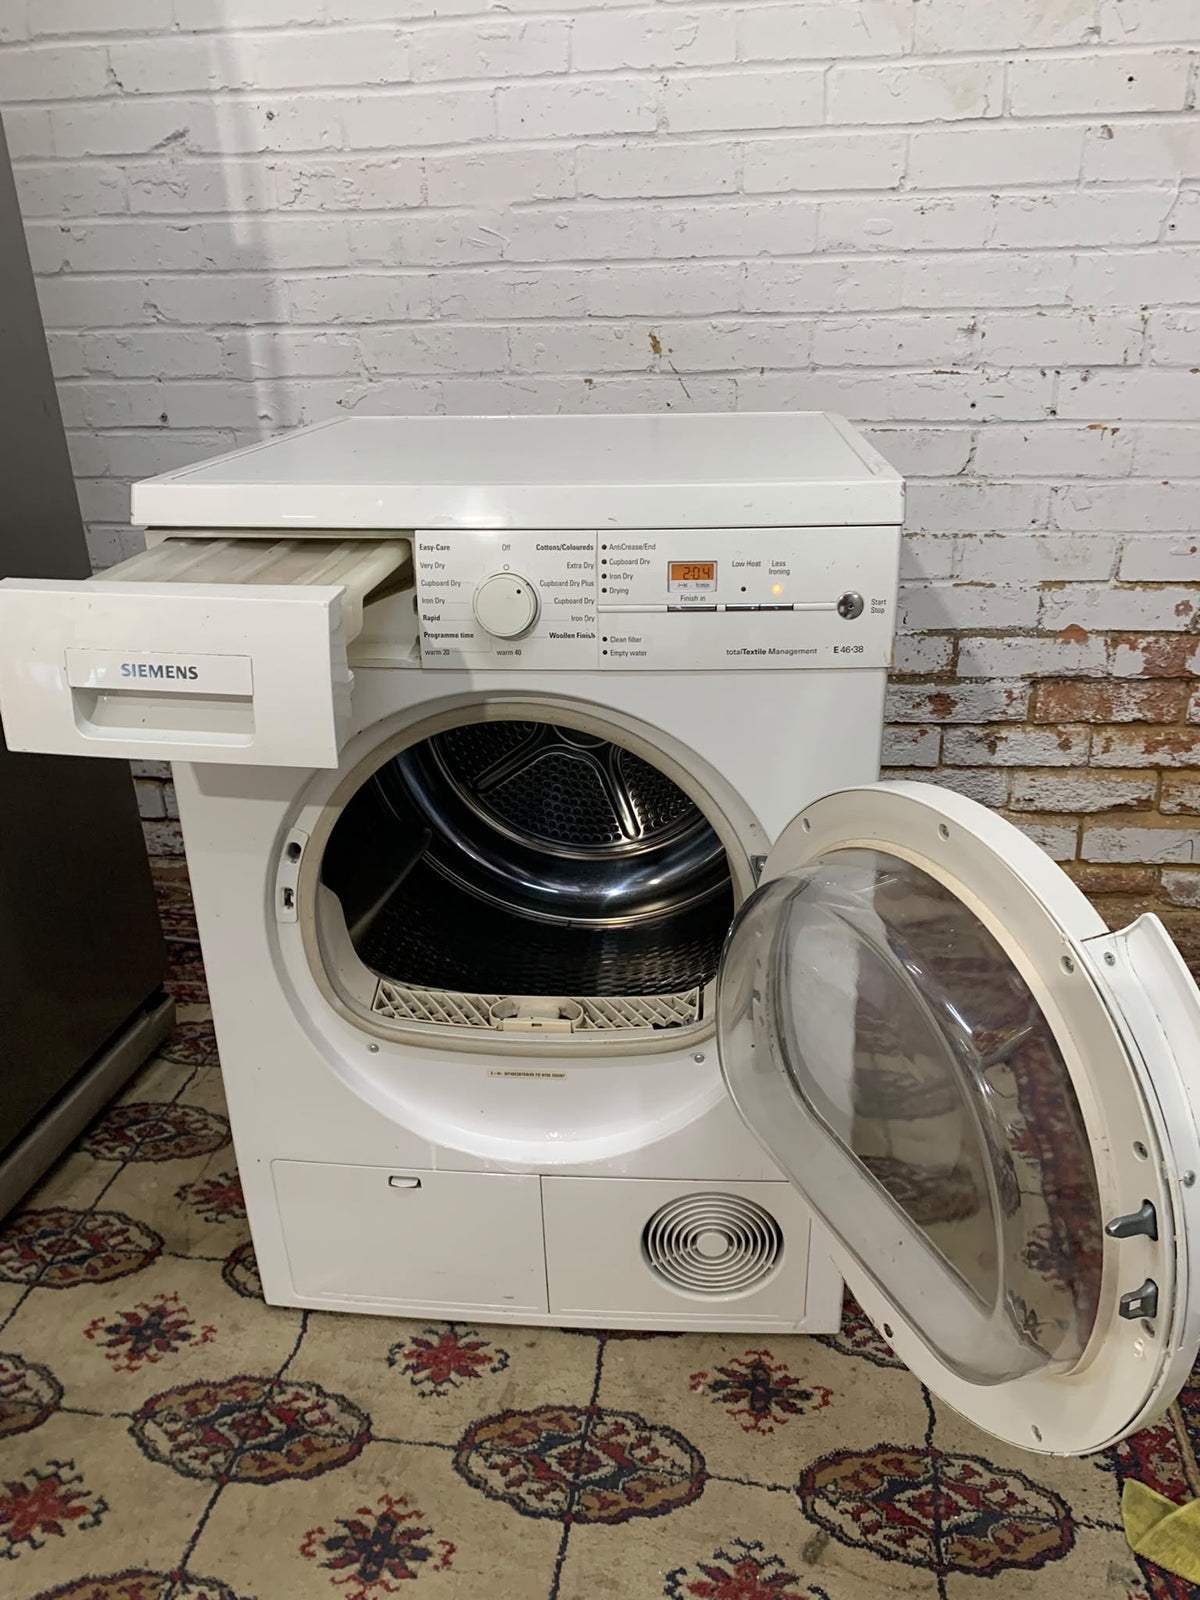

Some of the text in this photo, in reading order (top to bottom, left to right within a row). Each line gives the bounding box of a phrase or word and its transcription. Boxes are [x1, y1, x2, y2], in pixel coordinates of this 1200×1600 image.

[419, 544, 451, 552] Easy-Care
[420, 562, 446, 570] Very Dry
[583, 562, 594, 570] Dry
[609, 558, 638, 566] Cupboard
[769, 568, 790, 576] Ironing
[450, 580, 461, 588] Dry
[434, 597, 445, 605] Dry
[424, 632, 459, 640] Programme
[768, 648, 817, 656] Management
[833, 646, 839, 654] E
[121, 663, 199, 680] SIEMENS
